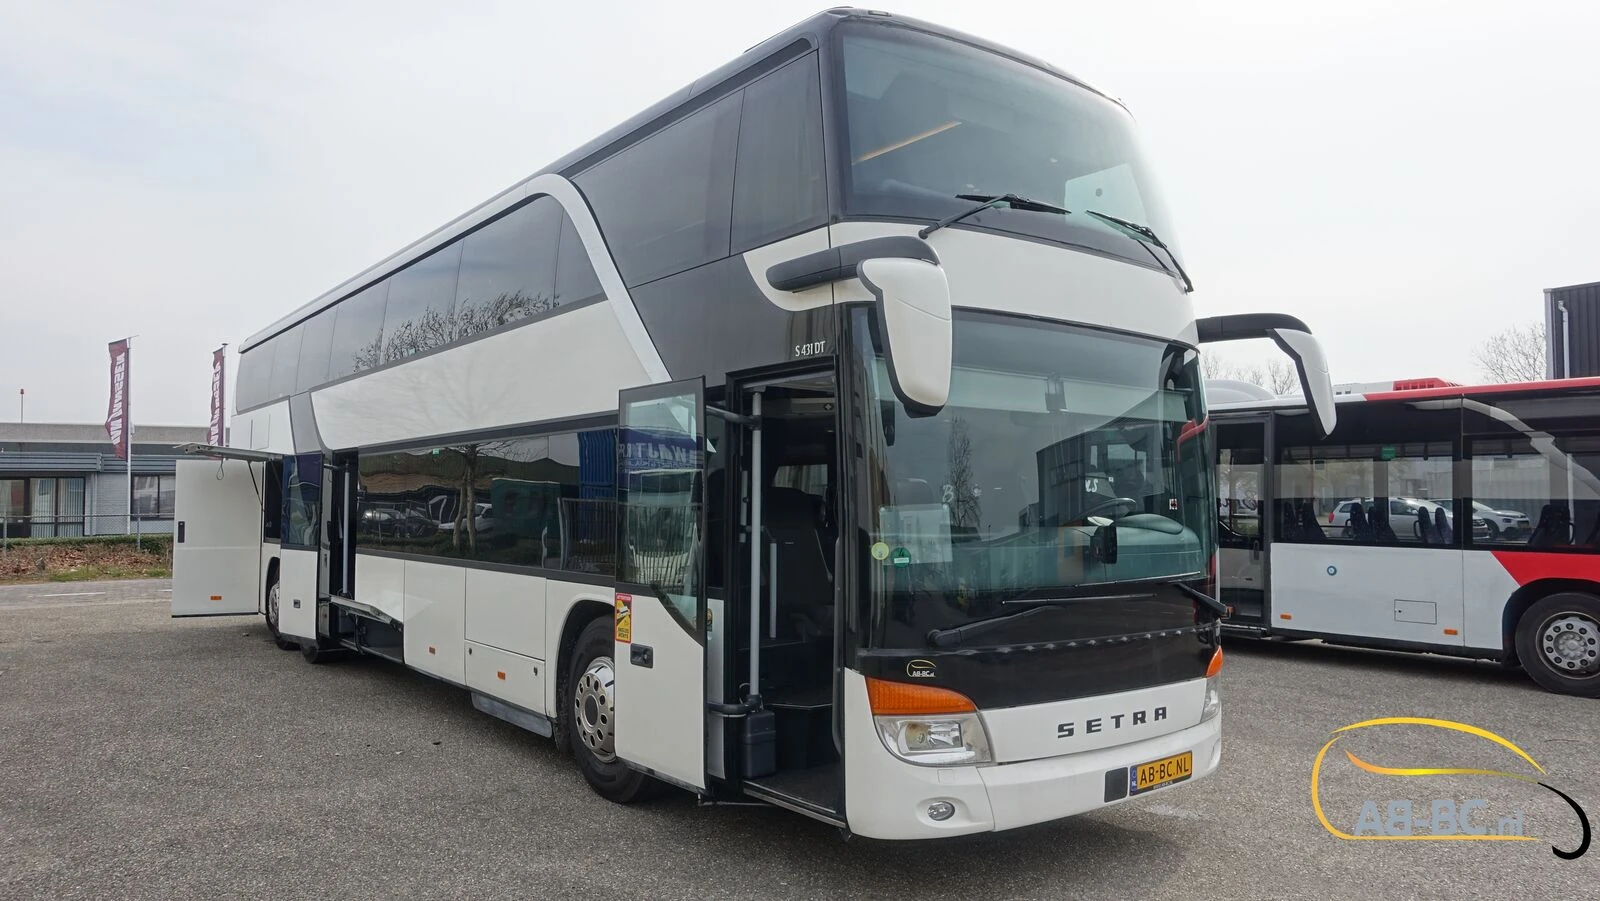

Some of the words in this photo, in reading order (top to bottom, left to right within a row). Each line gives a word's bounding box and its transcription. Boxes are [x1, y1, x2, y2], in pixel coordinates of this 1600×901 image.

[795, 345, 801, 357] S
[801, 343, 813, 356] 431
[814, 340, 826, 354] DT
[1057, 706, 1167, 739] SETRA
[1139, 757, 1189, 786] AB-BC.NL
